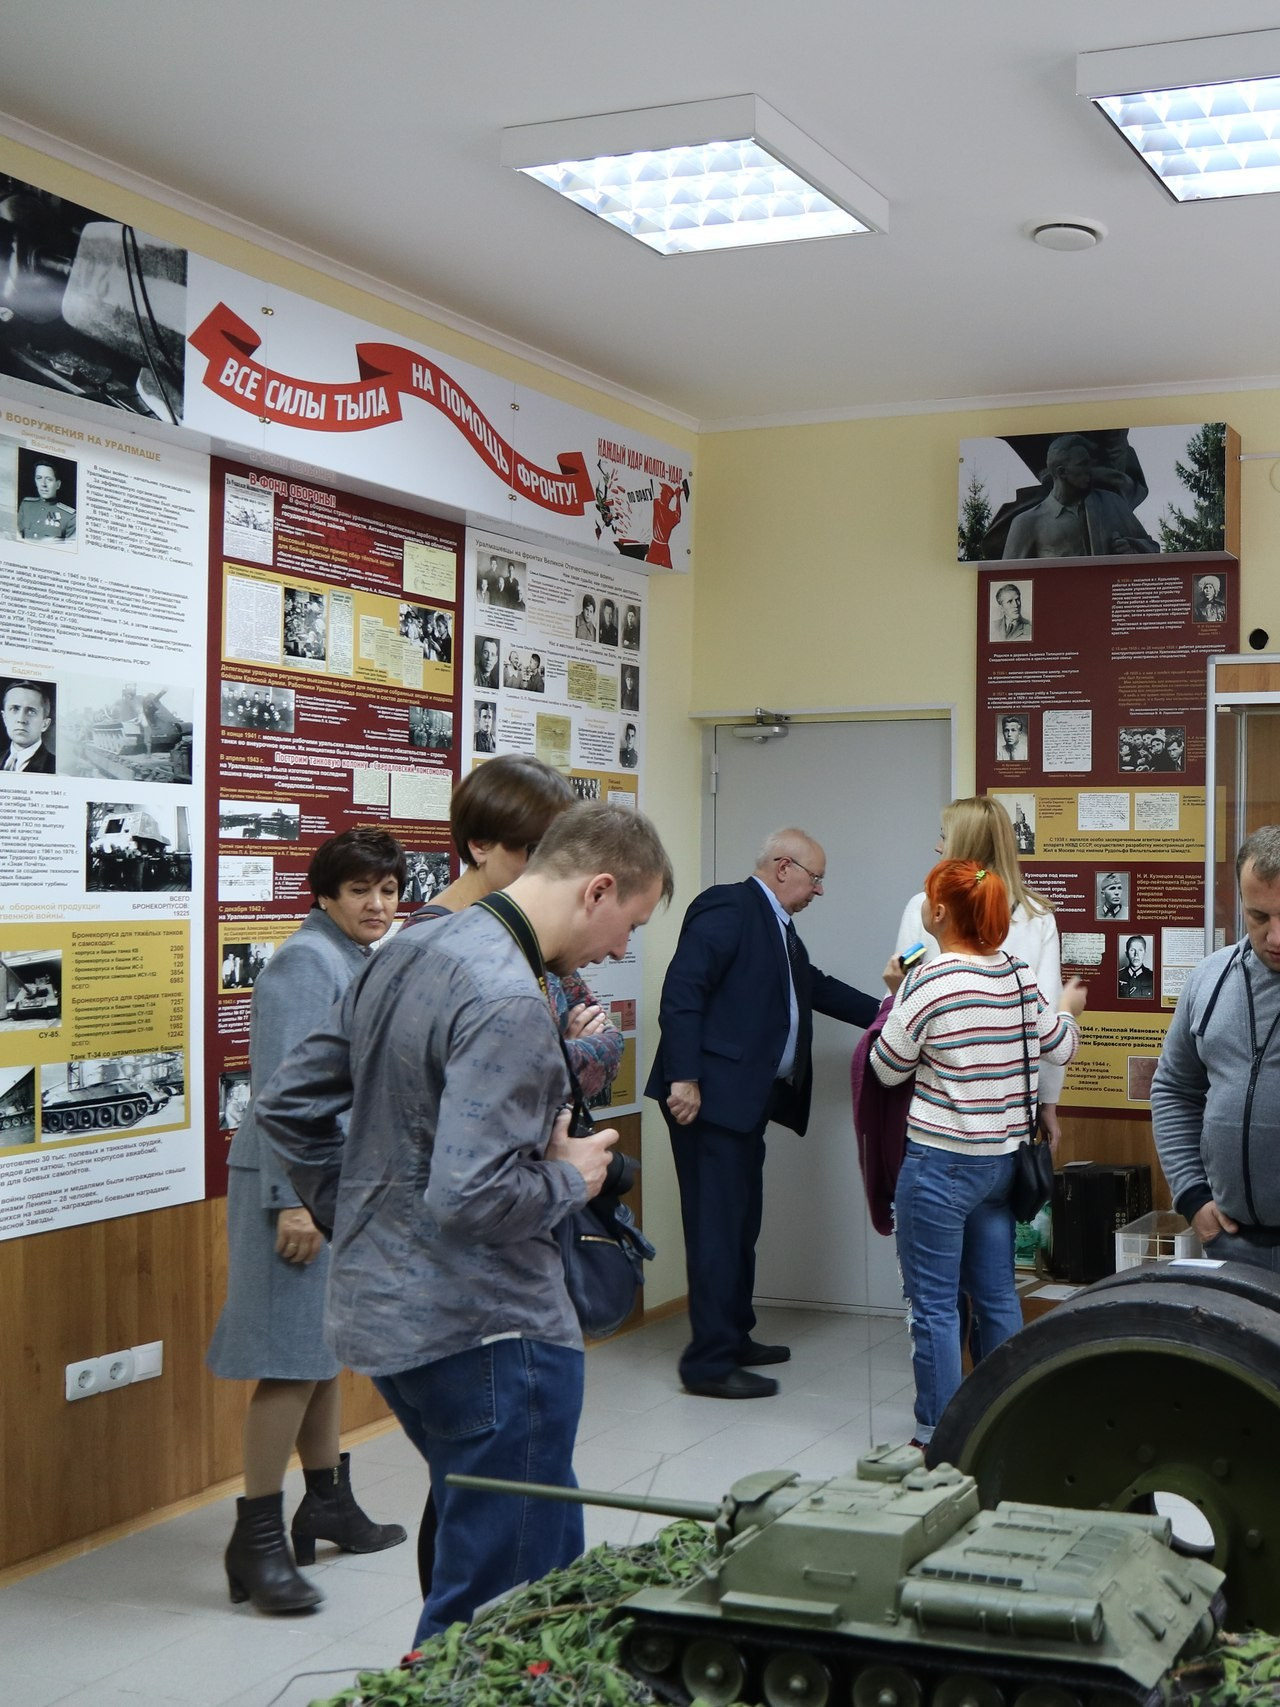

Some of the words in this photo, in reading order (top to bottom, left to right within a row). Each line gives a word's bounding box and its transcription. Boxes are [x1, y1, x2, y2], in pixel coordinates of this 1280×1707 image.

[219, 357, 262, 401] ВСЕ
[264, 380, 327, 420] СИЛЫ
[334, 386, 390, 421] ТЫЛА
[6, 412, 84, 441] ВООРУЖЕНИЯ
[87, 434, 102, 446] НА
[105, 438, 161, 462] УРАЛМАШЕ
[412, 362, 435, 396] НА
[440, 377, 510, 475] ПОМОЩЬ
[517, 463, 579, 506] ФРОНТУ!
[598, 437, 626, 465] КАЖДЫЙ
[627, 448, 643, 470] УДАР
[249, 472, 257, 485] В
[259, 475, 288, 497] ФОНД
[289, 483, 337, 509] ОБОРОНЫ!
[627, 491, 636, 503] ПО
